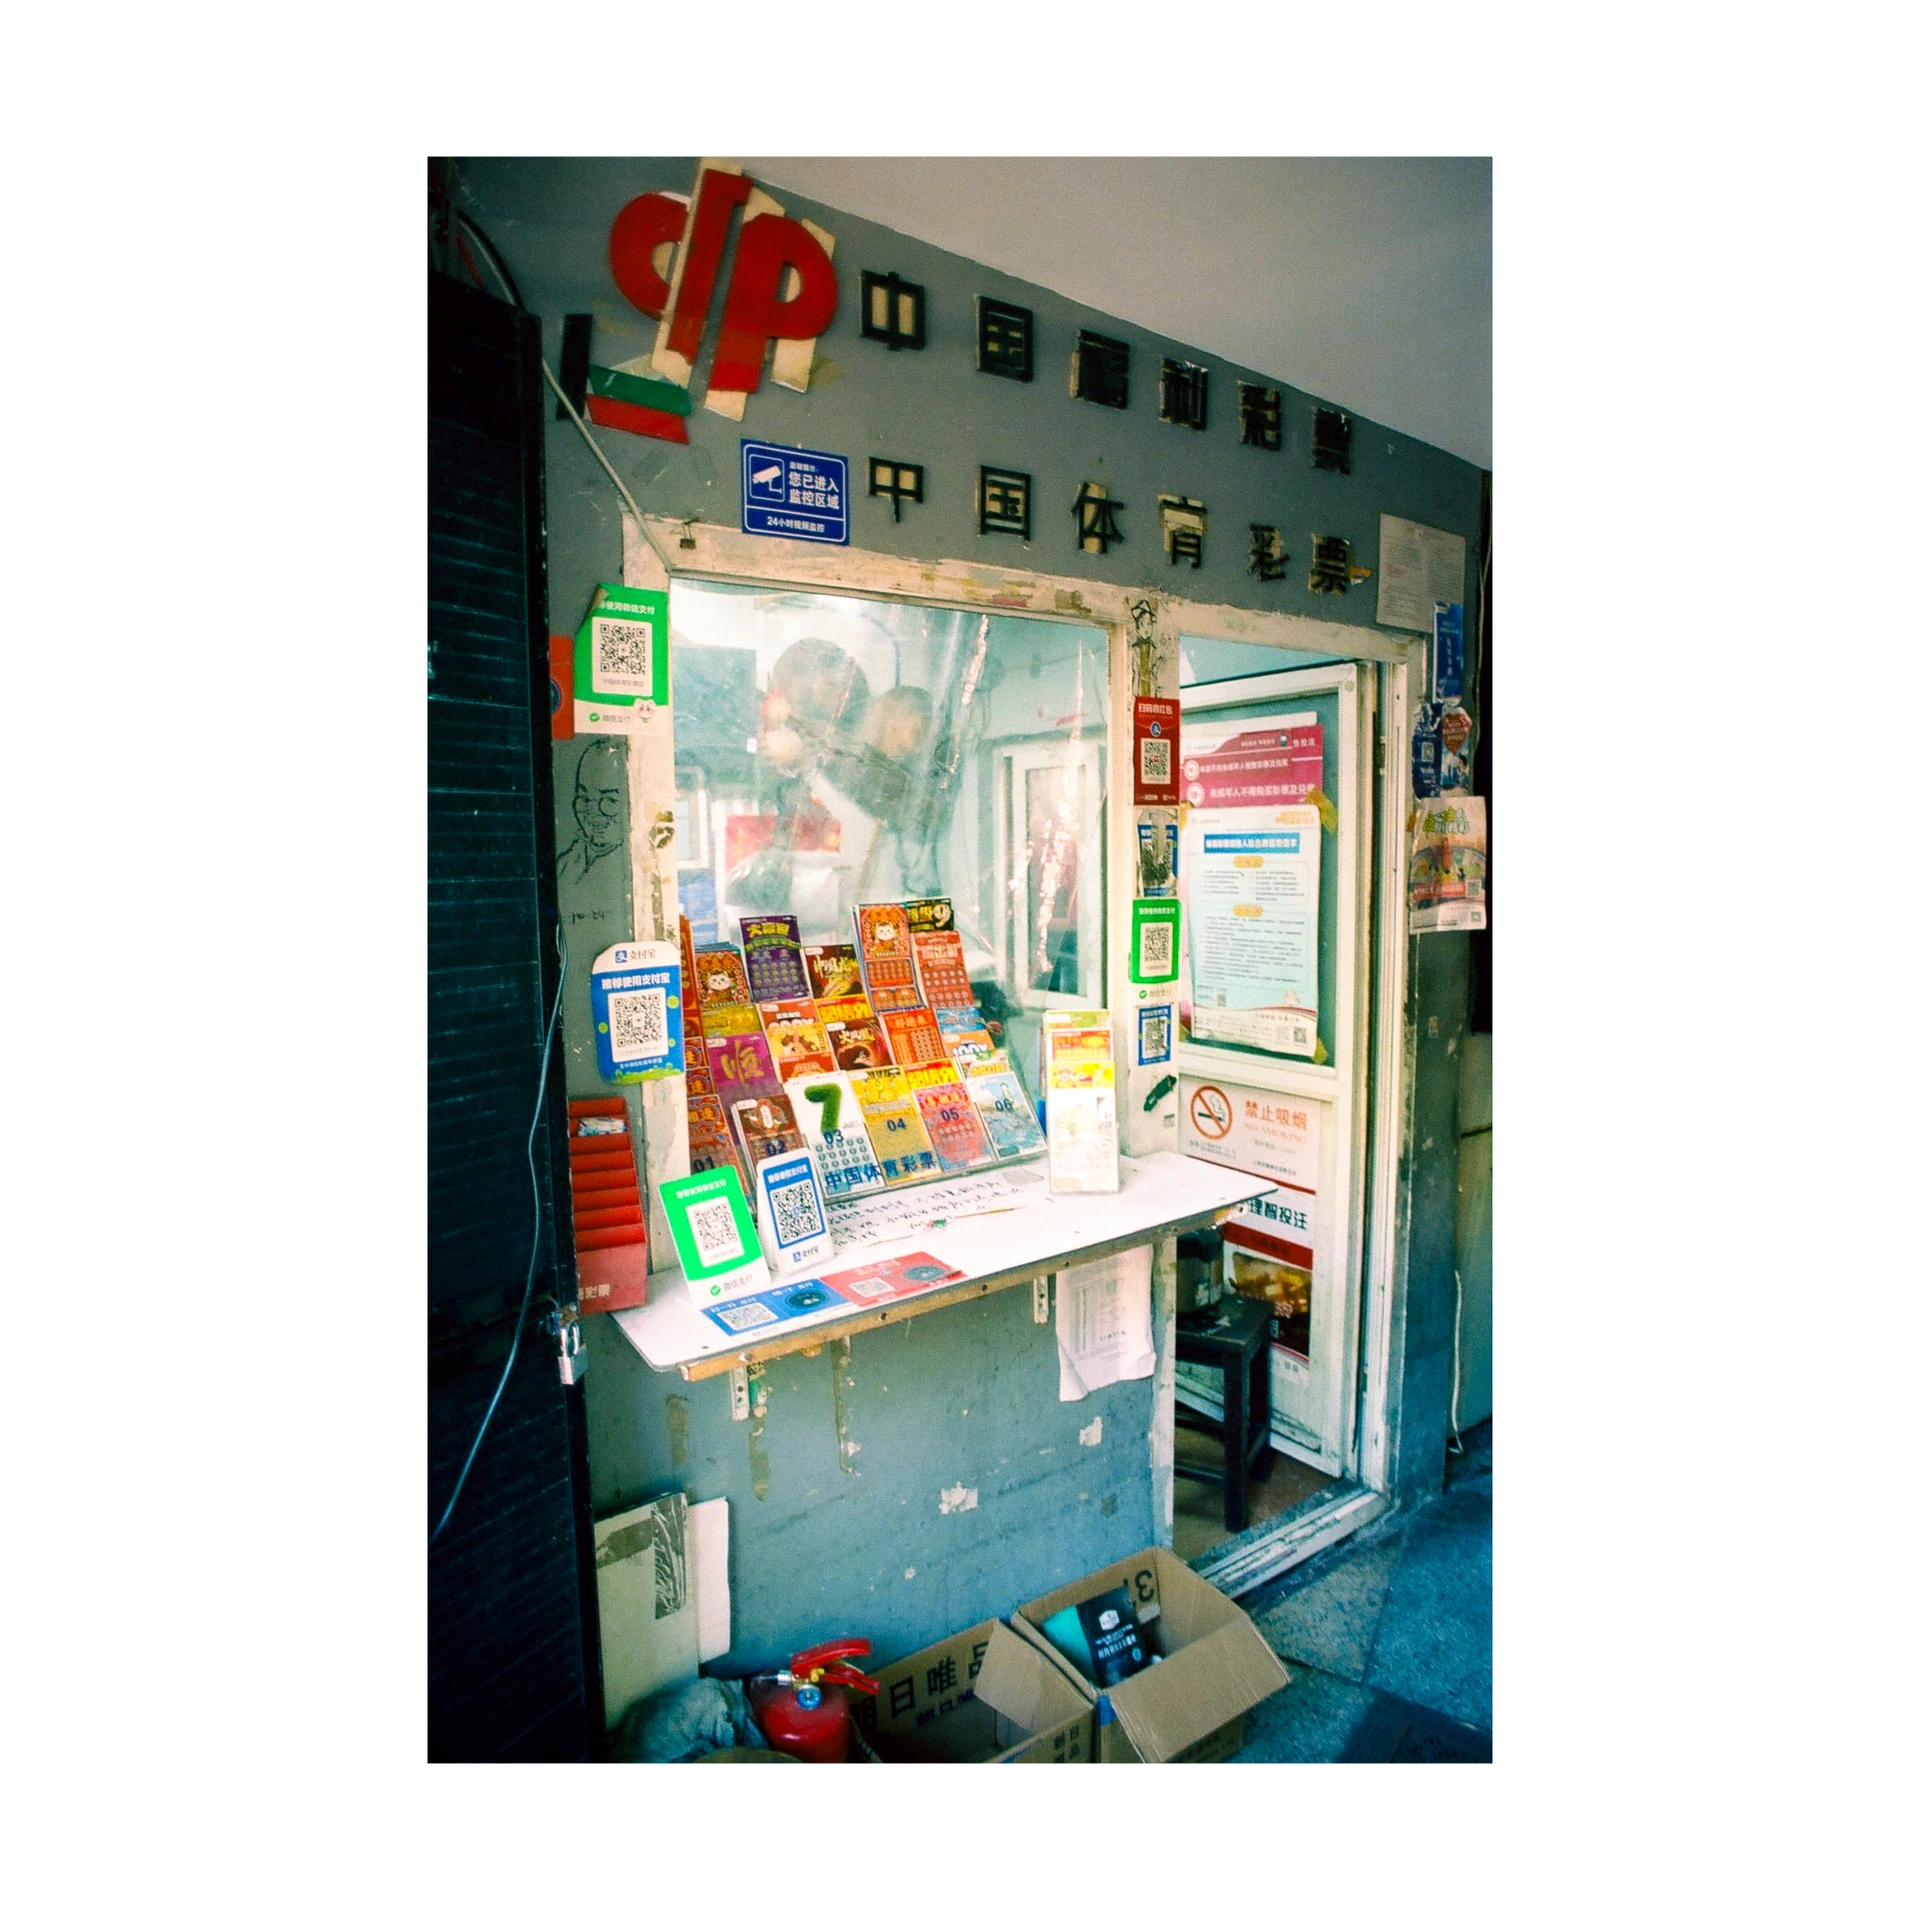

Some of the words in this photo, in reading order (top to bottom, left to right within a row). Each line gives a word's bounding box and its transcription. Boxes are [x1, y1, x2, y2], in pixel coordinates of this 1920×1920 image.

[861, 270, 1351, 474] 中国福利彩票
[788, 471, 839, 493] 您已进入
[788, 488, 839, 510] 监控区域
[766, 516, 825, 533] 24小时视频监控
[868, 455, 1352, 594] 中国体育彩票
[629, 949, 656, 961] 支付宝
[602, 973, 671, 990] 推荐使用支付宝
[804, 1082, 842, 1134] 7
[994, 1098, 1013, 1112] 06
[941, 1107, 959, 1122] 05
[1244, 1099, 1307, 1131] 禁止吸烟
[886, 1118, 906, 1132] 04
[823, 1129, 844, 1145] 03
[766, 1140, 787, 1156] 02
[693, 1156, 715, 1173] 01
[825, 1150, 936, 1188] 中国体育彩票
[1250, 1197, 1307, 1231] 理智投注
